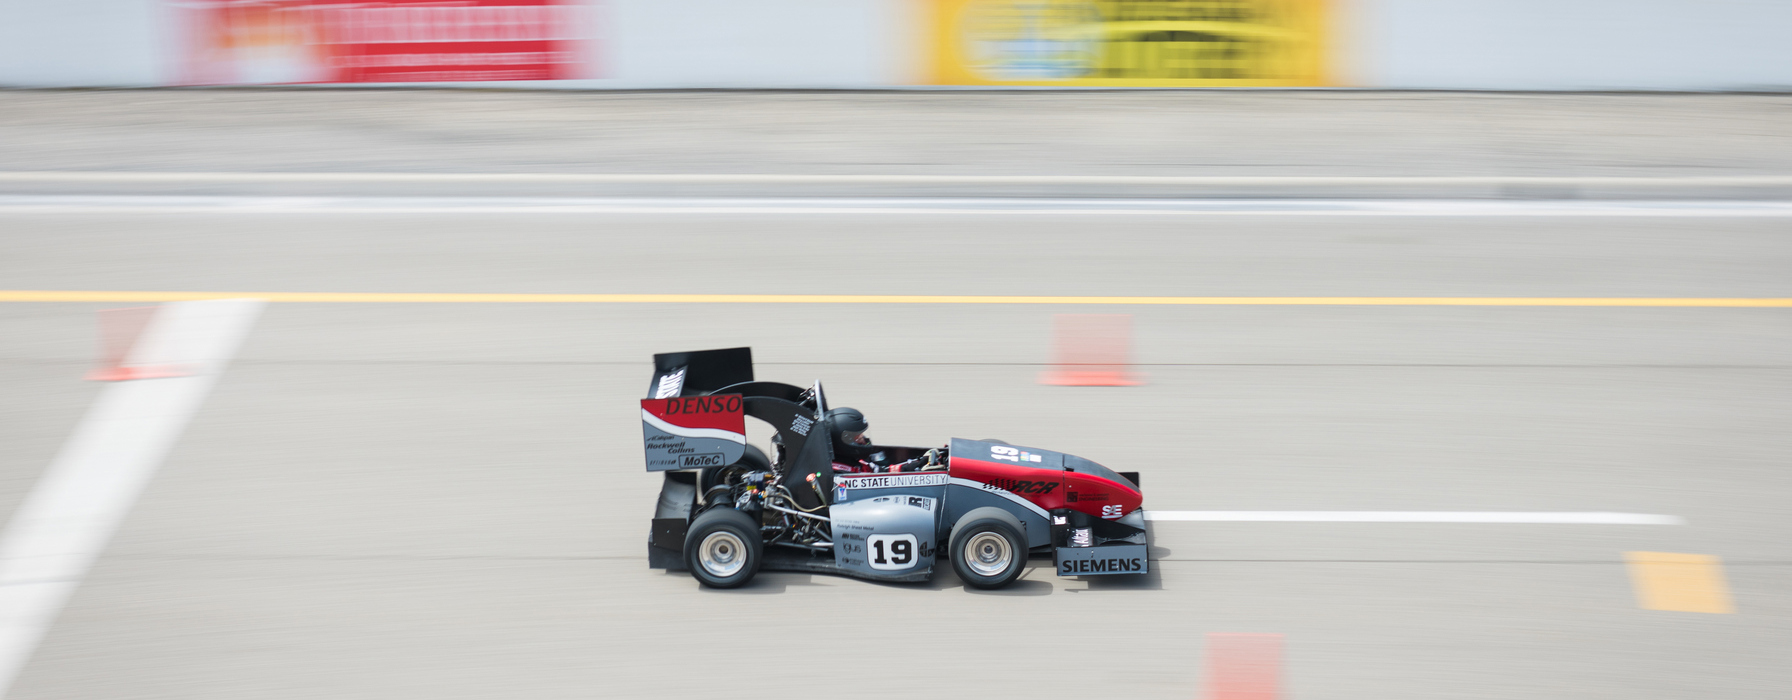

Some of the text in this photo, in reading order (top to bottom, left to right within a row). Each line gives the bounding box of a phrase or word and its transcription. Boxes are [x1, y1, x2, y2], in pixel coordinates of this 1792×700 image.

[666, 396, 742, 415] DENSO
[647, 442, 686, 450] Rockwell
[668, 447, 695, 455] Collins
[684, 455, 720, 466] MoTeC
[991, 446, 1019, 462] 19
[845, 475, 946, 488] NC STATE UNIVERSITY
[1013, 481, 1060, 494] RCR
[1102, 504, 1122, 516] SAE
[873, 540, 912, 565] 19
[1062, 558, 1141, 573] SIEMENS
